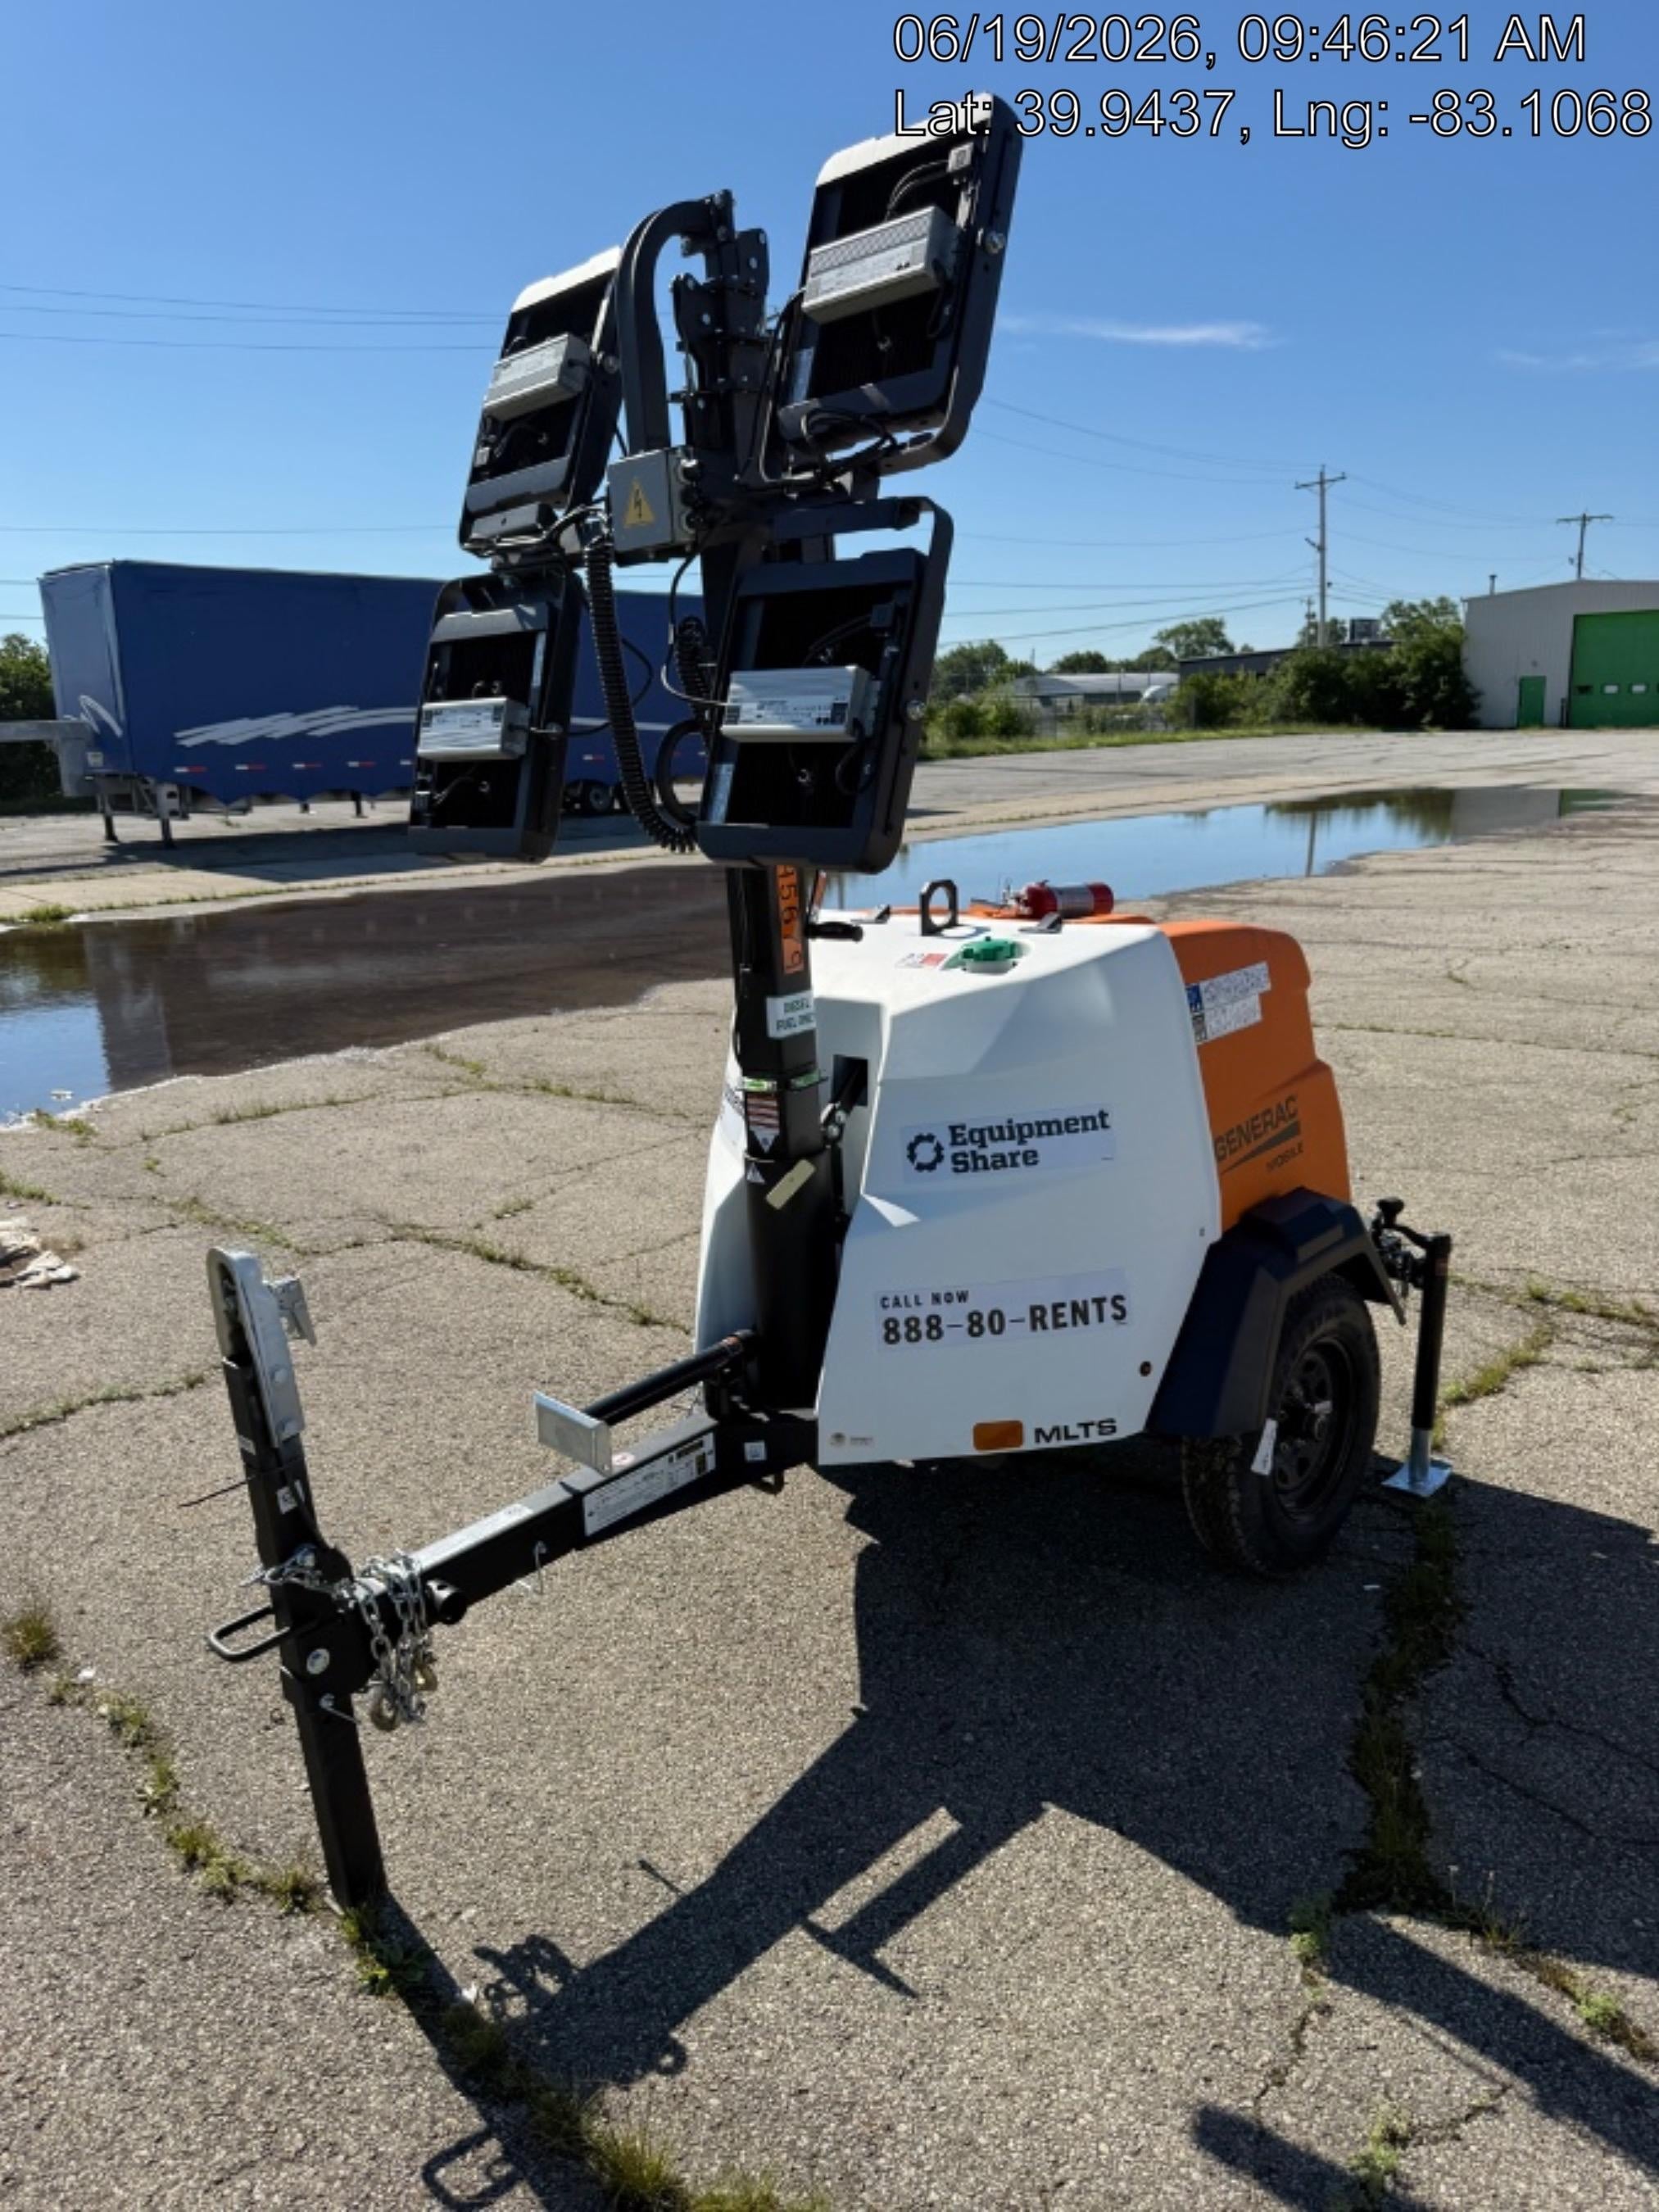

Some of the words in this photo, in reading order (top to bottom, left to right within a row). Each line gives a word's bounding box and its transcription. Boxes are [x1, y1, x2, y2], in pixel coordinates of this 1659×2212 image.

[949, 1109, 1111, 1149] Equipment
[1214, 1095, 1297, 1163] GENERAC
[951, 1149, 1039, 1173] Share
[880, 1294, 922, 1309] CALL
[931, 1290, 969, 1305] NOW
[882, 1294, 1128, 1344] 888-80-RENTS
[1035, 1417, 1117, 1444] MLTS
